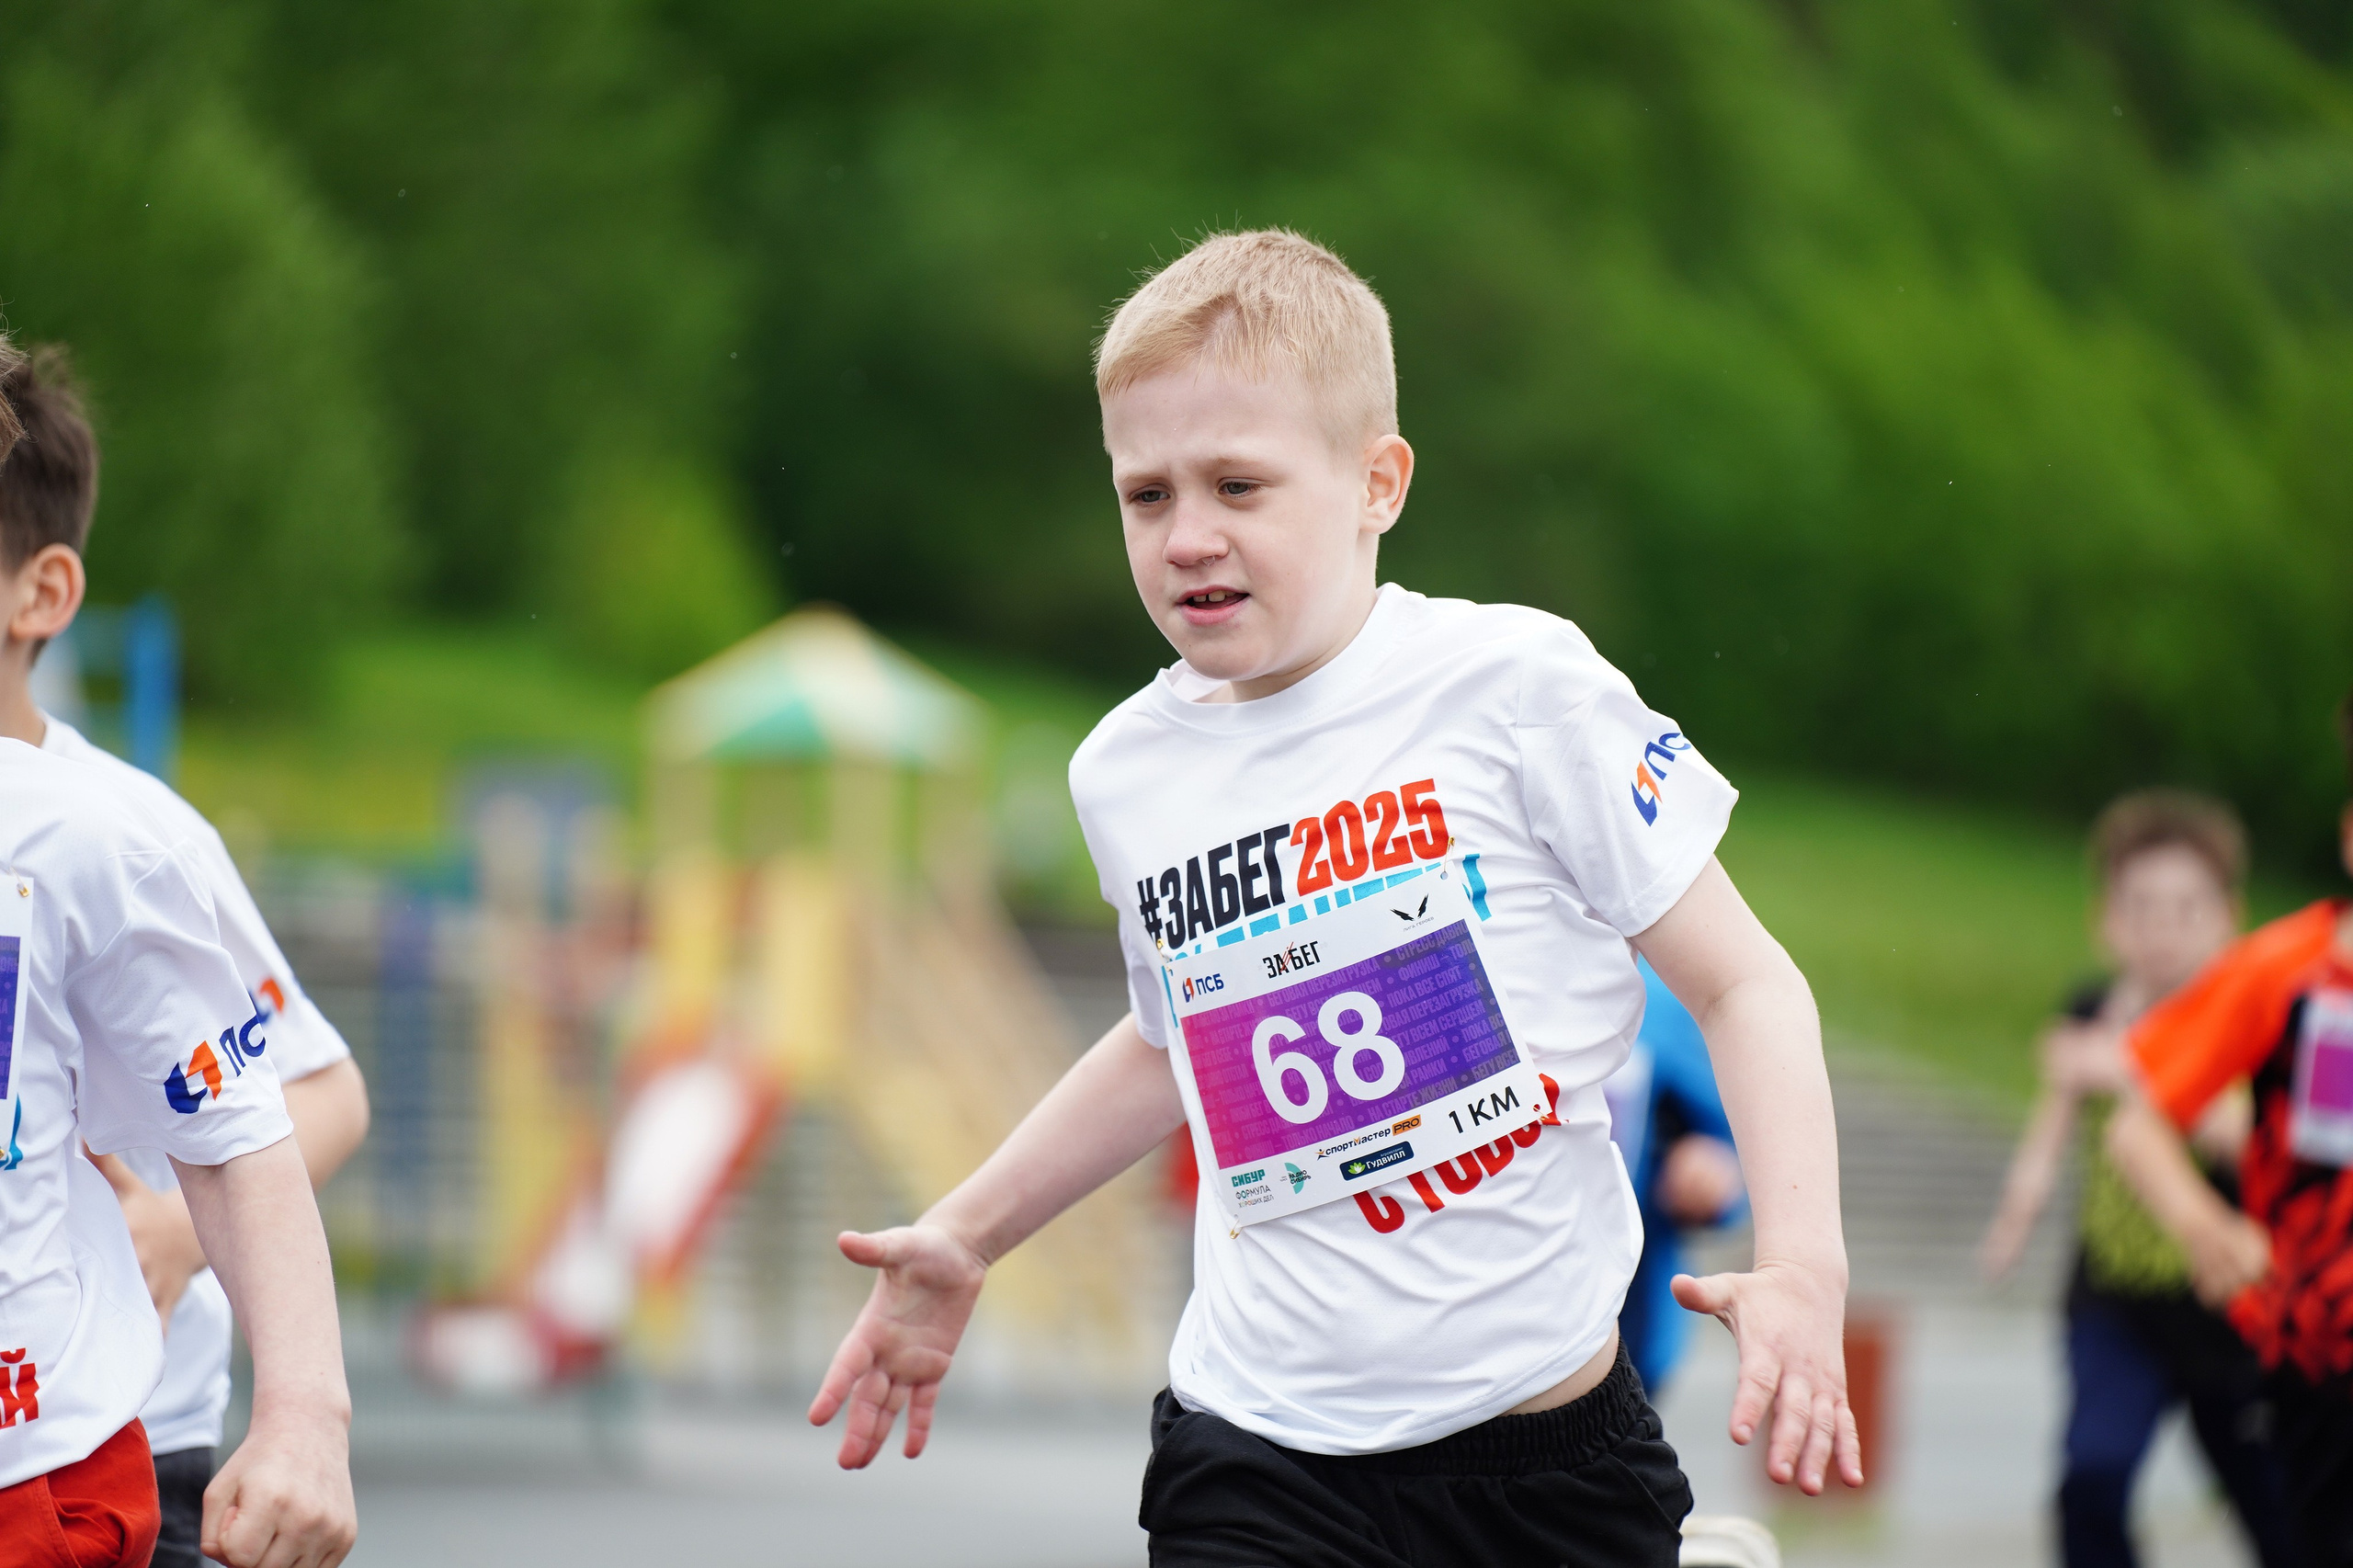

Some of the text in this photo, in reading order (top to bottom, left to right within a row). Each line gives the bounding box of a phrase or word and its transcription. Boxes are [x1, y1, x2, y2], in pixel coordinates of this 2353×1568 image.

[1644, 733, 1691, 780] ПС
[1394, 933, 1436, 960] СТРЕСС
[1267, 982, 1308, 1006] БЕГОВАЯ
[1306, 957, 1381, 994] ПЕРЕЗАГРУЗКА
[1396, 953, 1440, 983] ФИНИШ
[1195, 973, 1224, 995] ПСБ
[1386, 984, 1417, 1007] ПОКА
[1414, 975, 1437, 996] ВСЕ
[1434, 964, 1463, 989] СПЯТ
[1408, 977, 1483, 1020] ПЕРЕЗАГРУЗКА
[1409, 1018, 1439, 1042] ВСЕМ
[1438, 998, 1486, 1031] СЕРДЦЕМ
[1461, 1018, 1491, 1042] ПОКА
[1251, 991, 1405, 1125] 68
[1461, 1031, 1507, 1062] БЕГОВАЯ
[1410, 1057, 1448, 1085] РАМКИ
[1471, 1058, 1497, 1081] БЕГУ
[1367, 1104, 1384, 1123] НА
[1381, 1091, 1420, 1118] СТАРТЕ
[1417, 1074, 1458, 1104] ЖИЗНИ
[1449, 1110, 1463, 1133] 1
[1468, 1085, 1520, 1127] КМ
[1314, 1114, 1355, 1140] НАЧАЛО
[1394, 1118, 1419, 1134] PRO
[1232, 1169, 1265, 1187] СИБУР
[1289, 1170, 1307, 1179] РАДИО
[1290, 1175, 1311, 1184] СИБИРЬ
[1235, 1185, 1271, 1199] ФОРМУЛА
